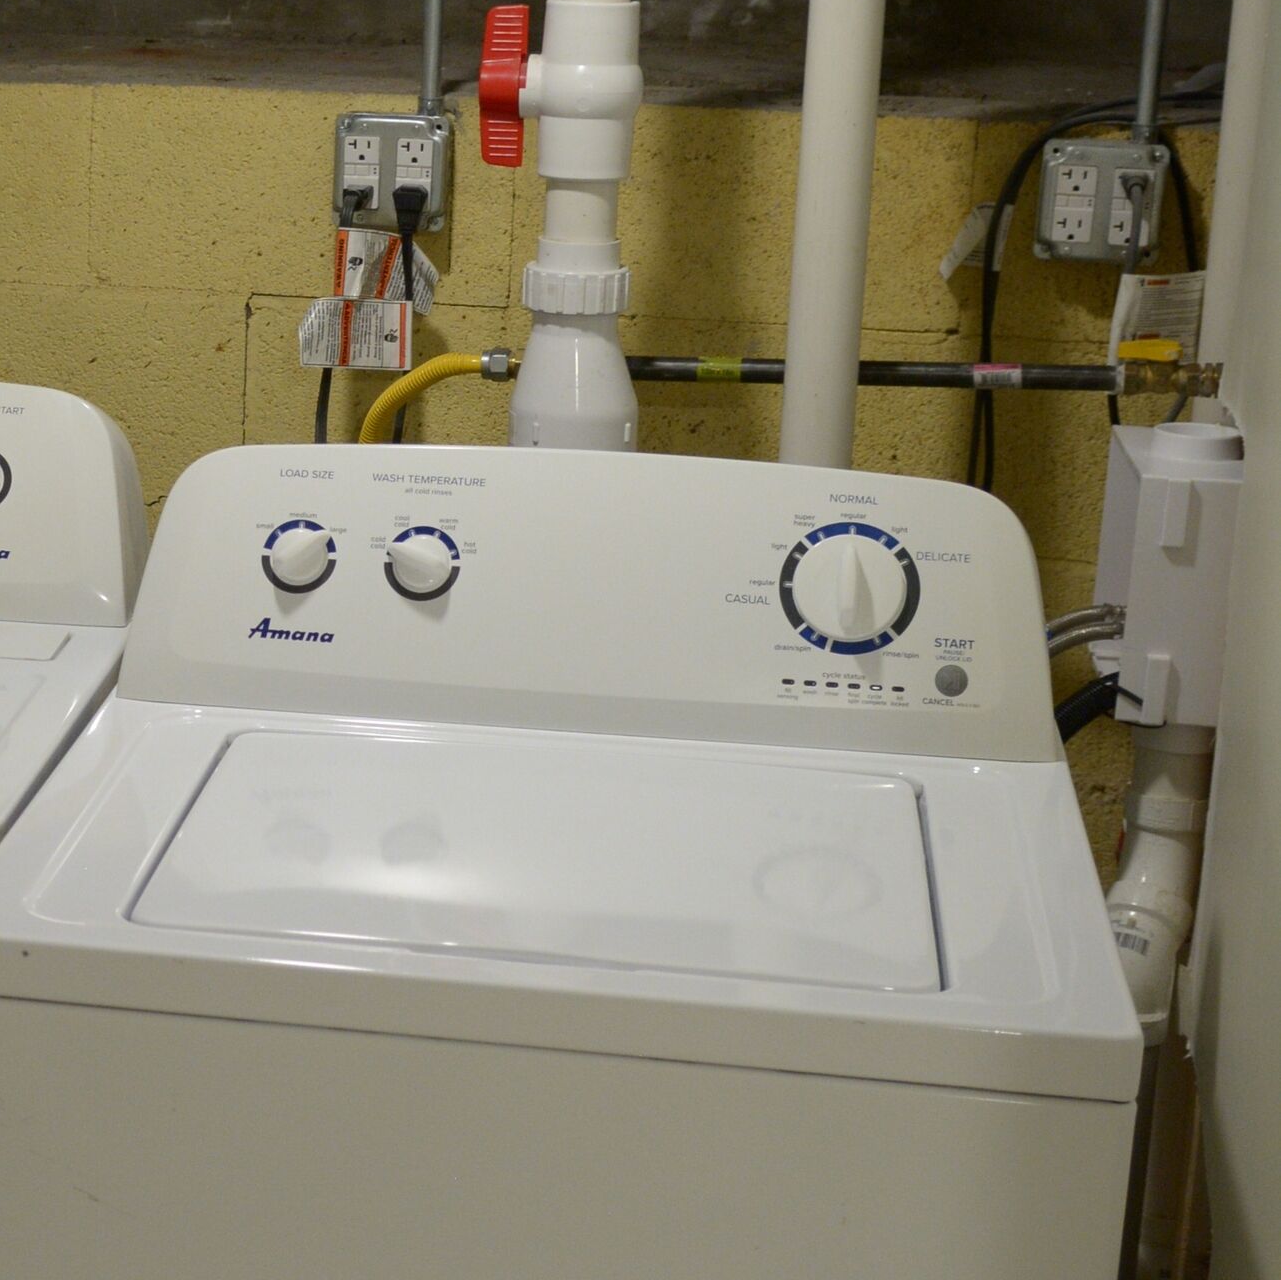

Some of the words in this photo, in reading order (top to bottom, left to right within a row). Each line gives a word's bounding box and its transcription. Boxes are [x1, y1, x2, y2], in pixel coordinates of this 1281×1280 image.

[336, 238, 345, 282] WARNING
[279, 468, 309, 479] LOAD
[312, 470, 335, 480] SIZE
[371, 472, 405, 484] WASH
[408, 474, 487, 488] TEMPERATURE
[829, 494, 879, 506] NORMAL
[794, 514, 815, 522] super
[840, 512, 867, 520] regular
[255, 522, 275, 530] small
[793, 520, 815, 529] heavy
[329, 526, 347, 534] large
[891, 526, 909, 534] light
[370, 542, 386, 550] cold
[771, 543, 788, 551] light
[915, 551, 971, 564] DELICATE
[725, 593, 771, 606] CASUAL
[248, 618, 335, 644] Amana
[774, 644, 811, 652] drain/spin
[935, 638, 975, 650] START
[883, 651, 919, 659] rinse/spin
[821, 672, 841, 680] cycle
[922, 697, 955, 707] CANCEL
